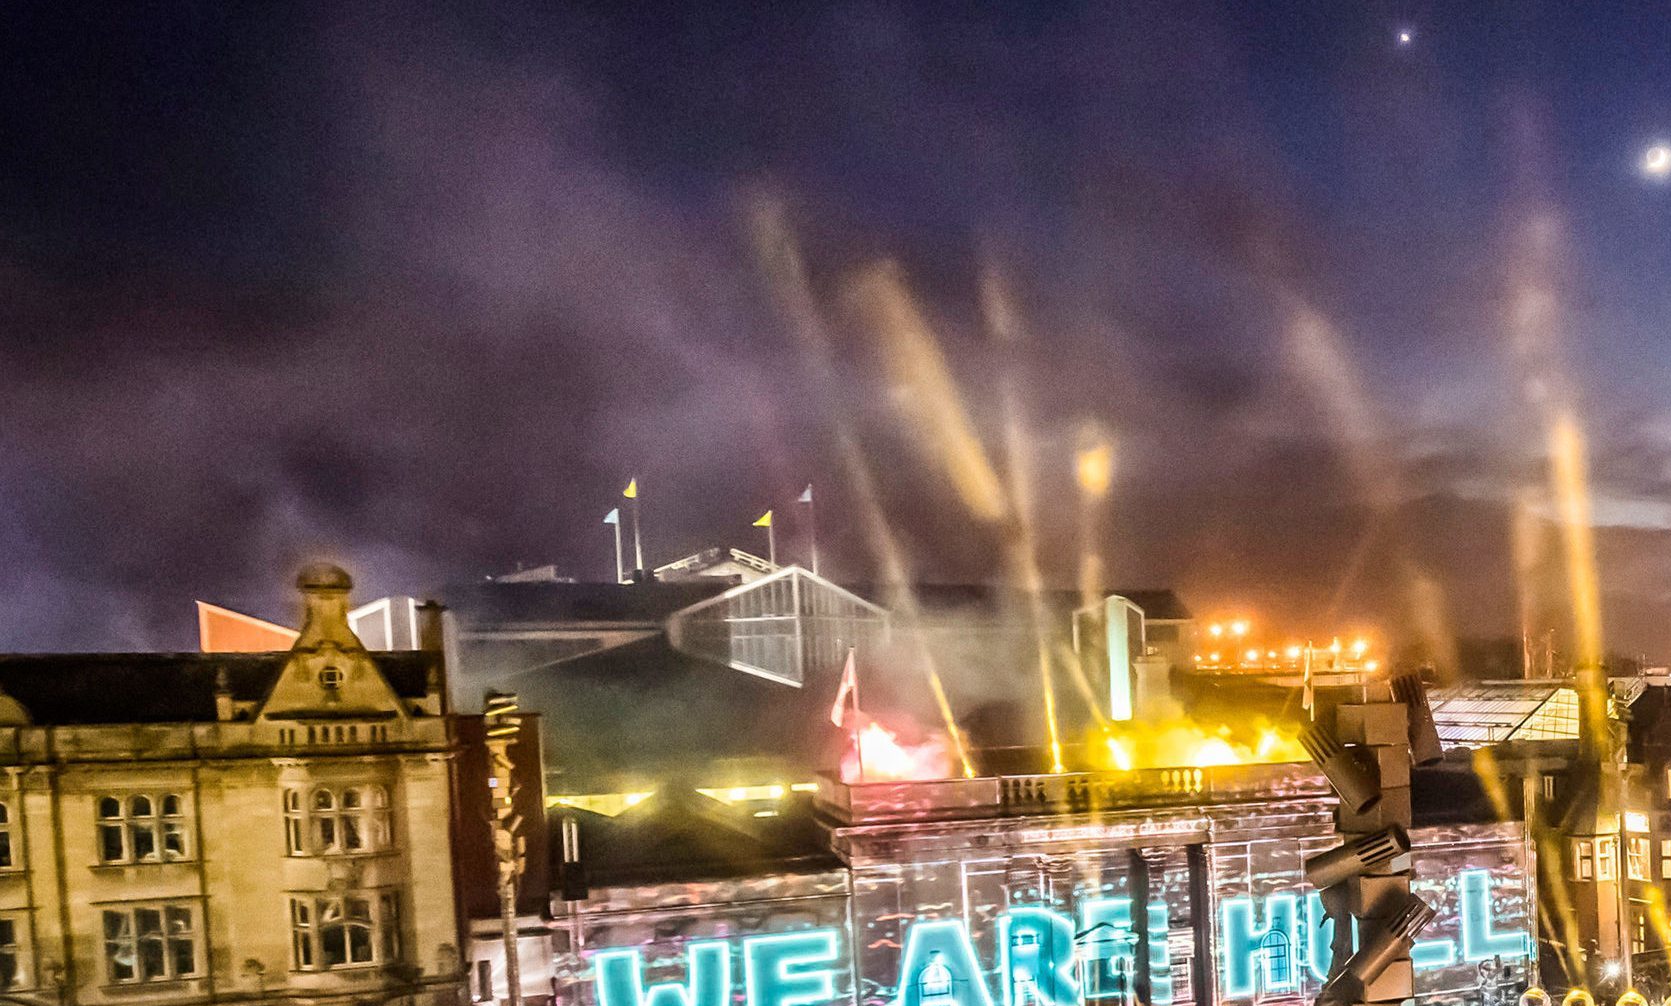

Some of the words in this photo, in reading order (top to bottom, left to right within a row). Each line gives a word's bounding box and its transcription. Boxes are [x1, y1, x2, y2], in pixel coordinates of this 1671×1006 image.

[1107, 822, 1137, 838] ART
[1138, 819, 1198, 836] GALLERY
[1222, 867, 1537, 999] HUL
